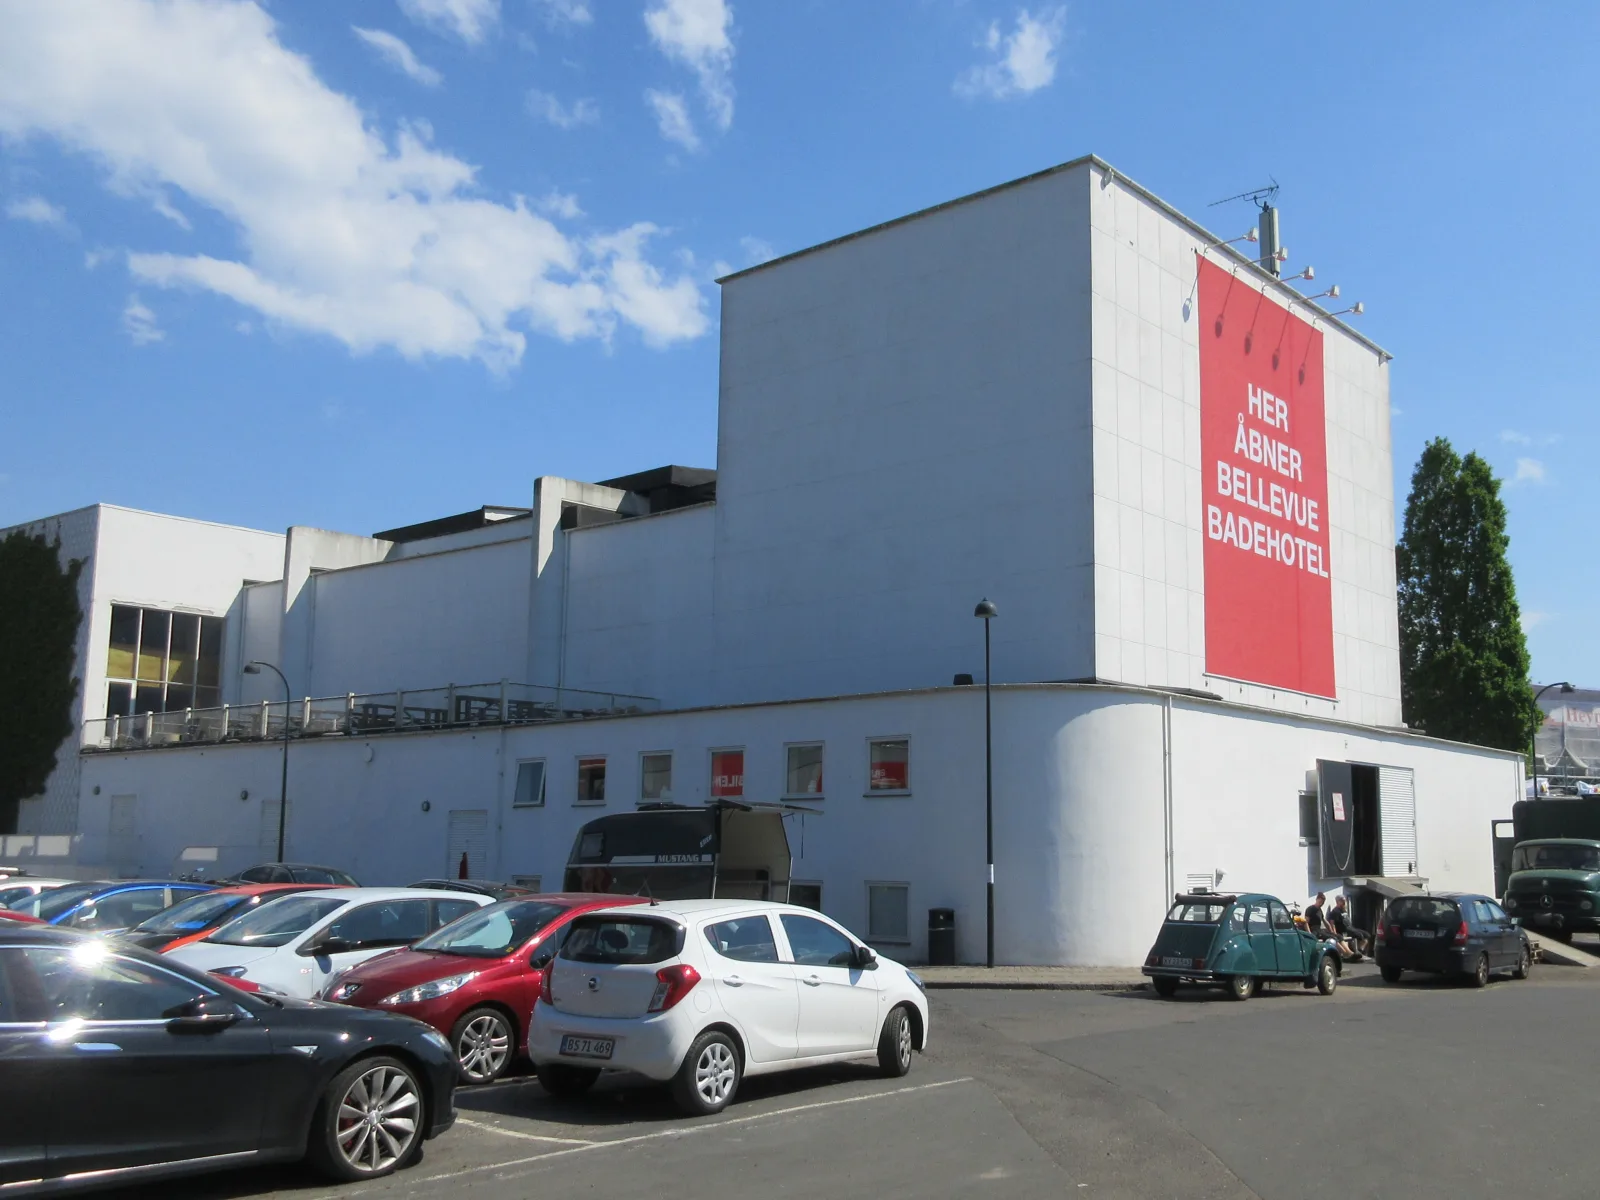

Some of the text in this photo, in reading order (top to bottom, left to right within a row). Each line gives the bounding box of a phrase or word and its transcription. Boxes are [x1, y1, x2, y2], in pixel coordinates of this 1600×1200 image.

[1247, 382, 1289, 433] HER
[1233, 412, 1303, 482] ÅBNER
[1217, 460, 1320, 533] BELLEVUE
[1207, 503, 1329, 579] BADEHOTEL
[657, 854, 700, 863] MUSTANG
